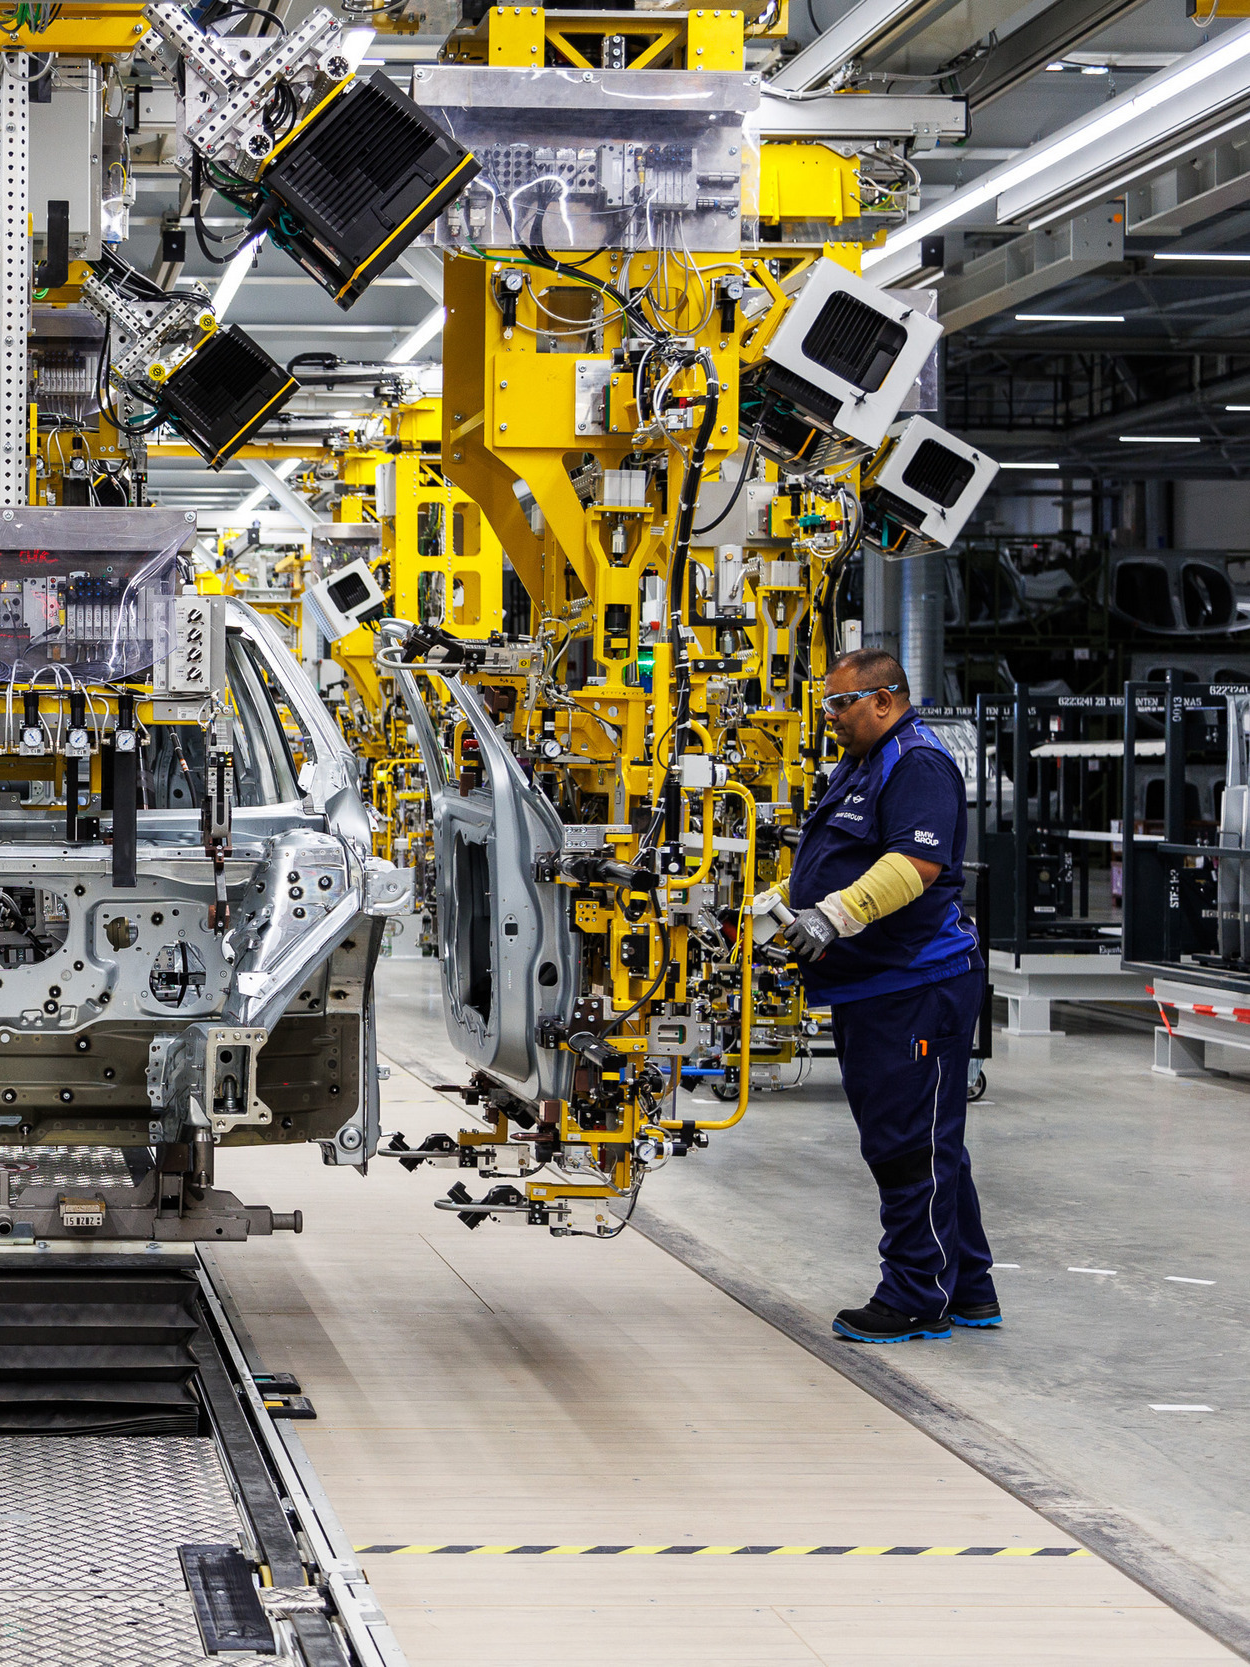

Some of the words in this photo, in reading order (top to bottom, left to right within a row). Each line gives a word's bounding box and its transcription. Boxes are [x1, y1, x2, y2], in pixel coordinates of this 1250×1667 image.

[1172, 696, 1182, 722] 0013
[844, 812, 864, 821] GROUP
[914, 830, 934, 839] BMW
[914, 836, 939, 846] GROUP
